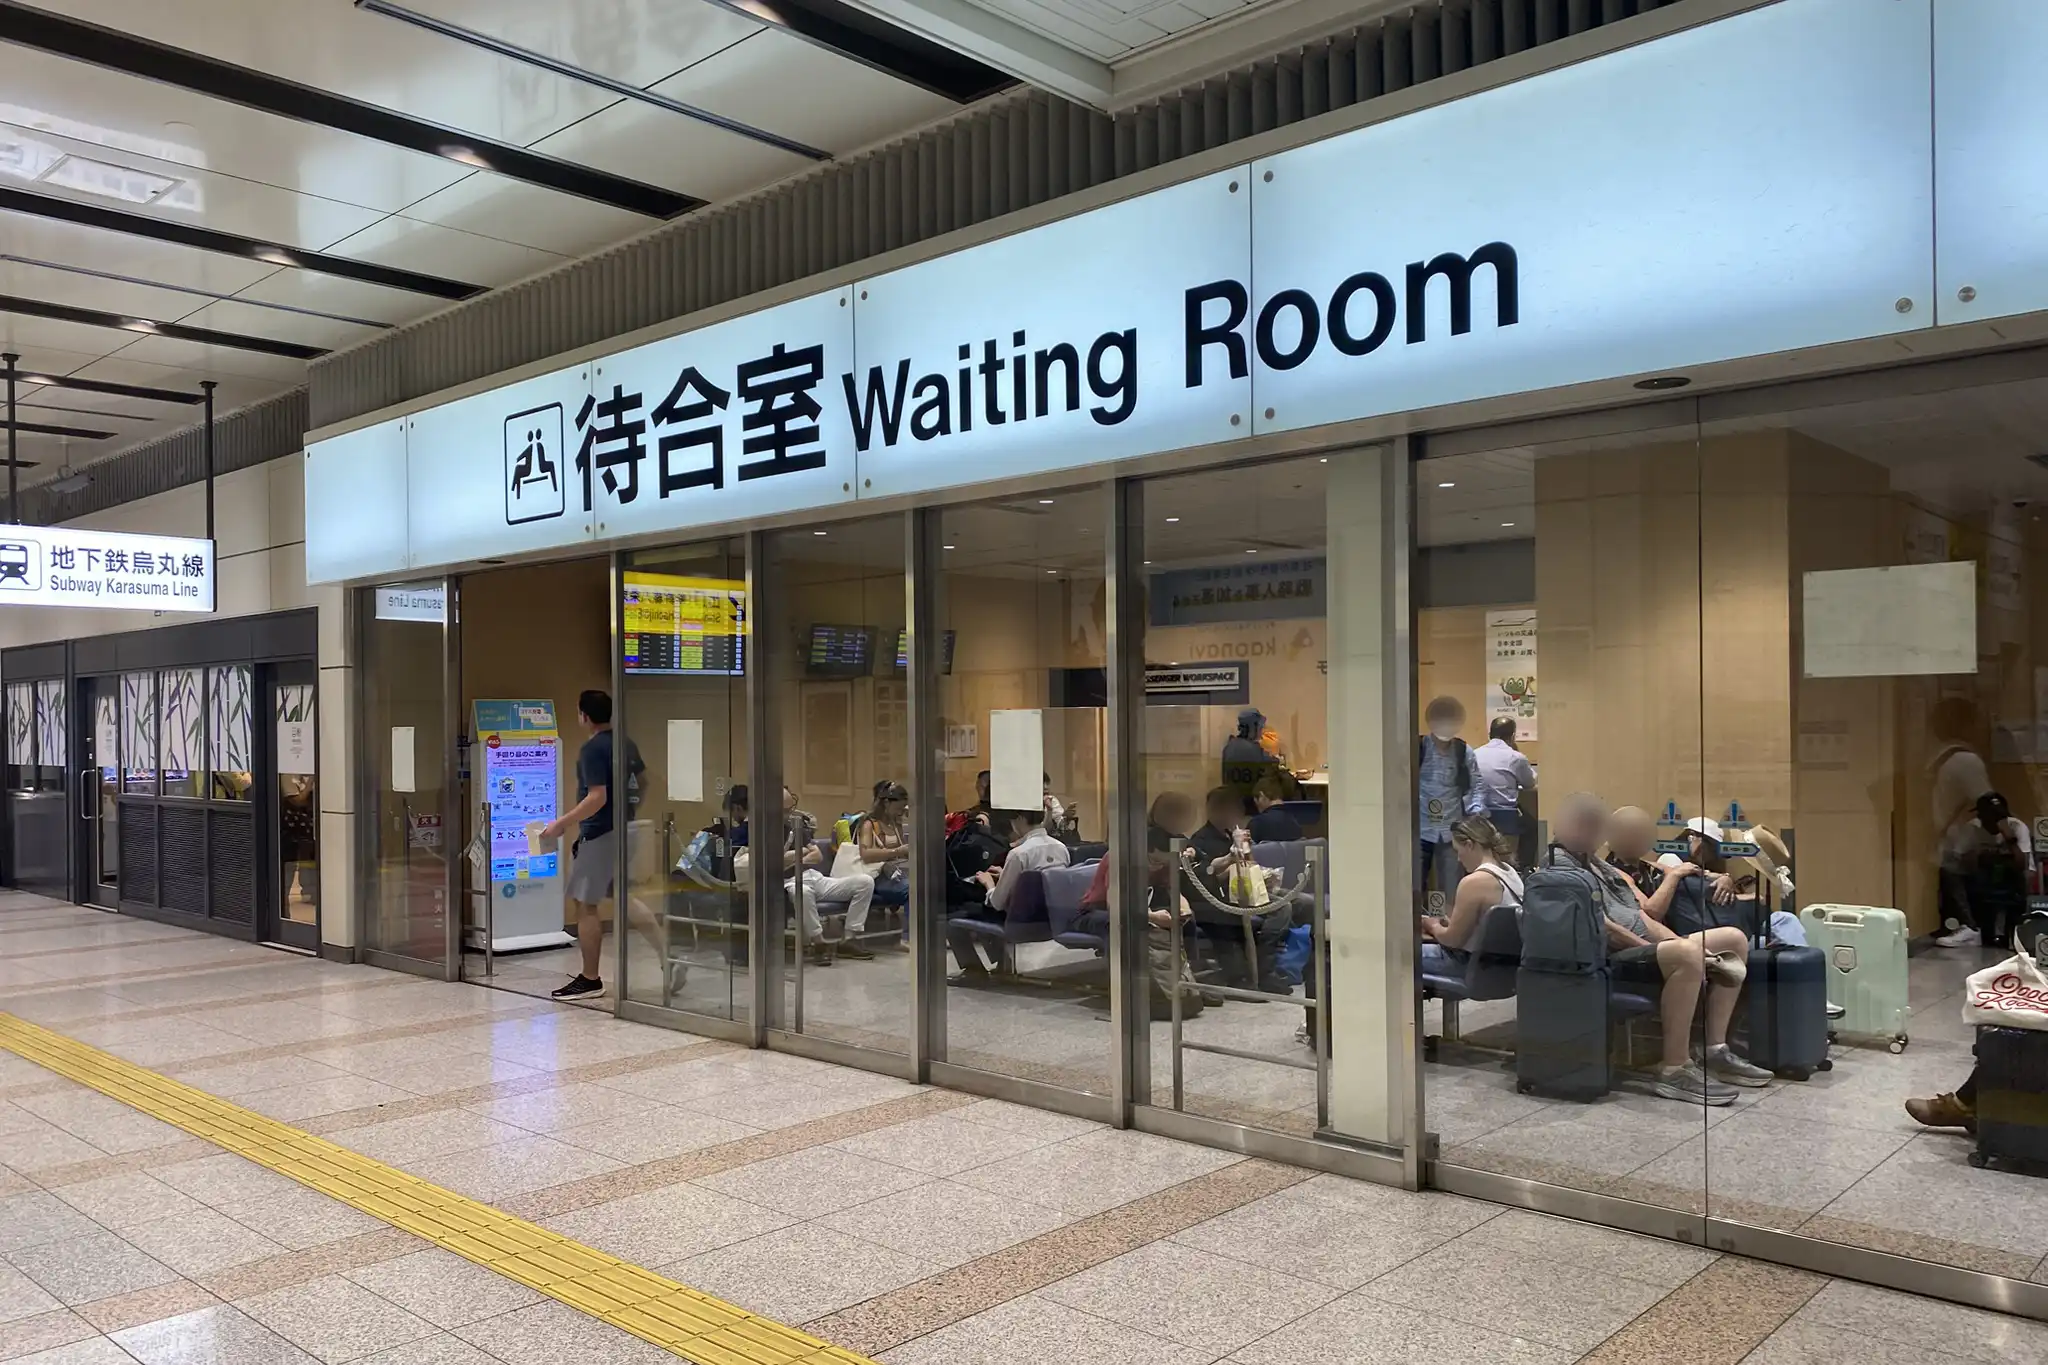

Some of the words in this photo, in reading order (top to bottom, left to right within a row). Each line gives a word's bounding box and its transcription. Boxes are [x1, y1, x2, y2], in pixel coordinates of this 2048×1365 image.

[573, 343, 828, 509] 待合室
[841, 328, 1138, 452] Waiting
[1185, 240, 1519, 388] Room
[50, 545, 204, 577] 地下鉄烏丸線
[50, 575, 101, 596] Subway
[106, 578, 168, 596] Karasuma
[172, 581, 198, 597] Line
[1183, 671, 1234, 683] WORKSPACE
